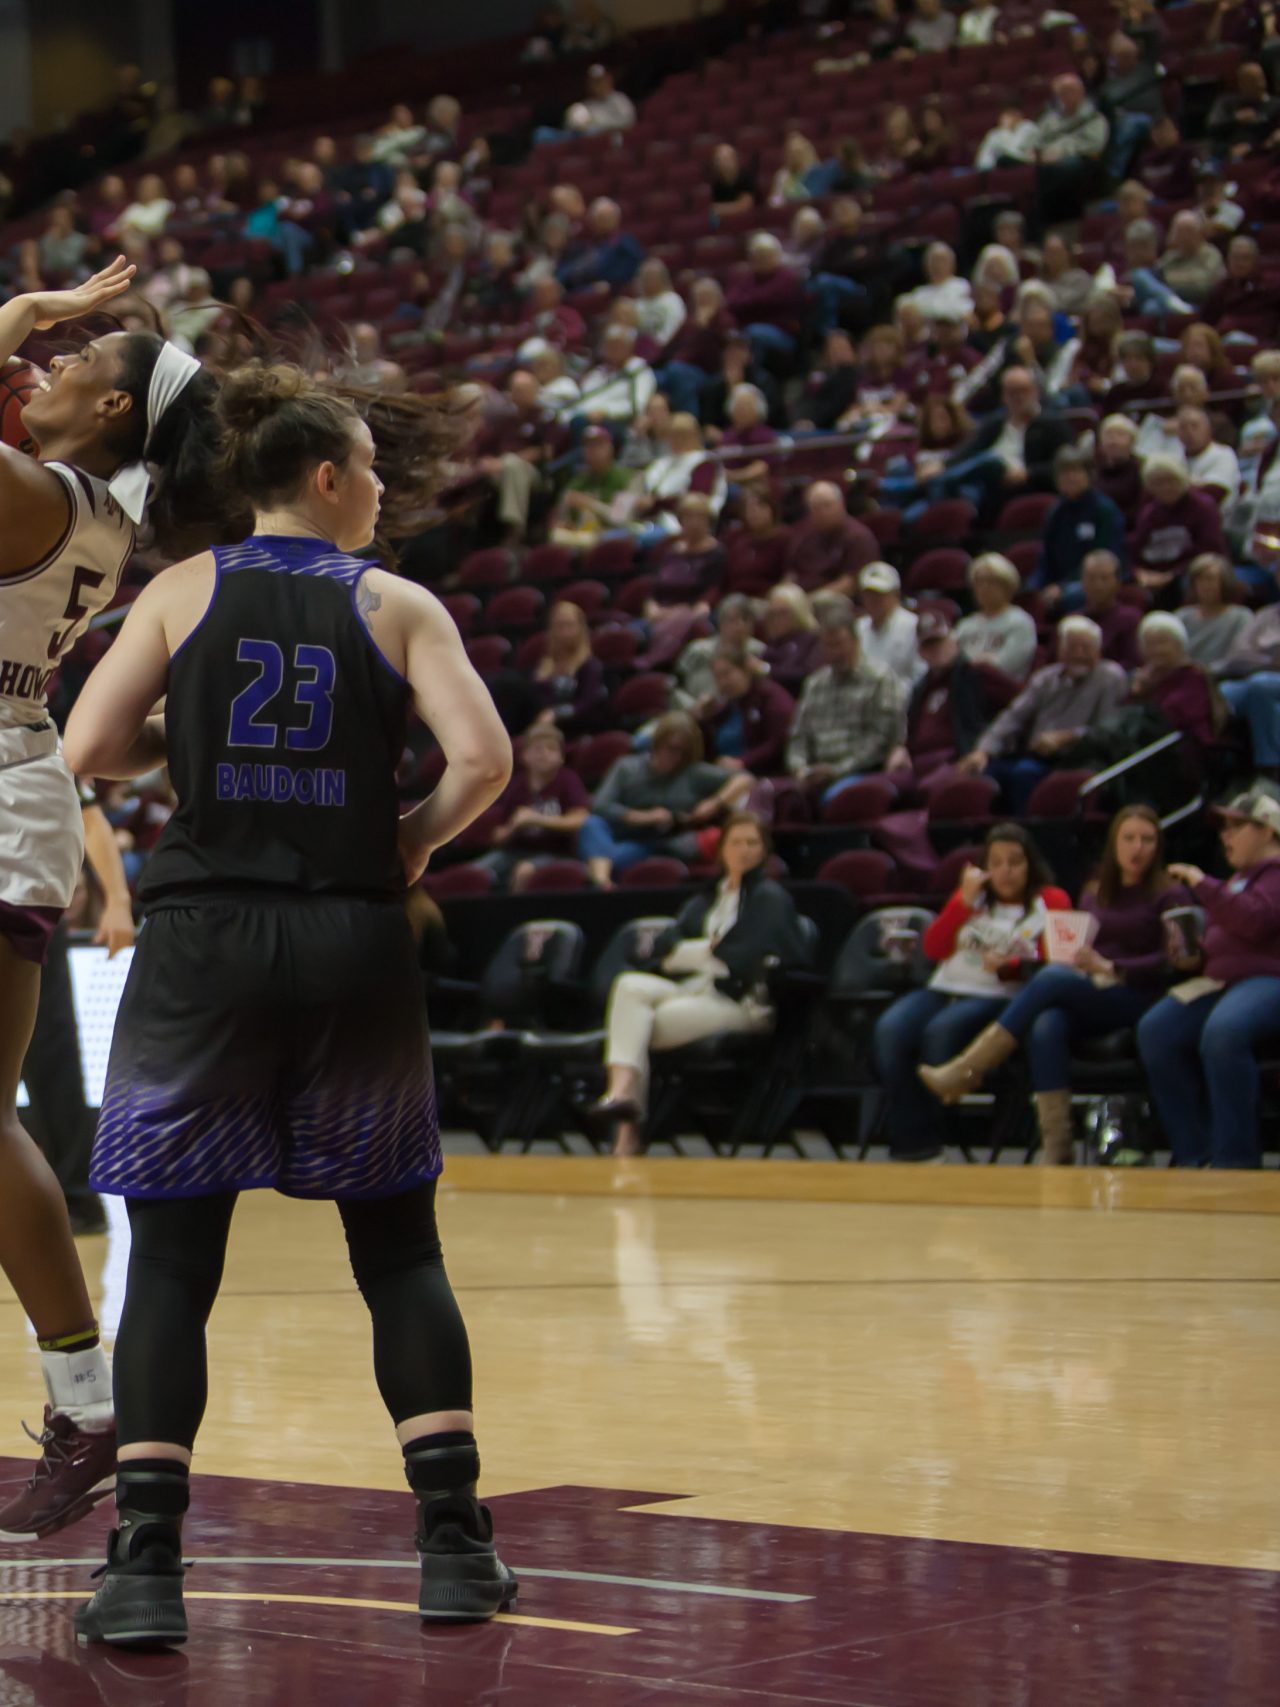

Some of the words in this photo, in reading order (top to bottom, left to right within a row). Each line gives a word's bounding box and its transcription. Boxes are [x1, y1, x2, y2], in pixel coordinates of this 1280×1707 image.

[47, 565, 106, 660] 5
[227, 638, 336, 751] 23
[216, 763, 345, 806] BAUDOIN
